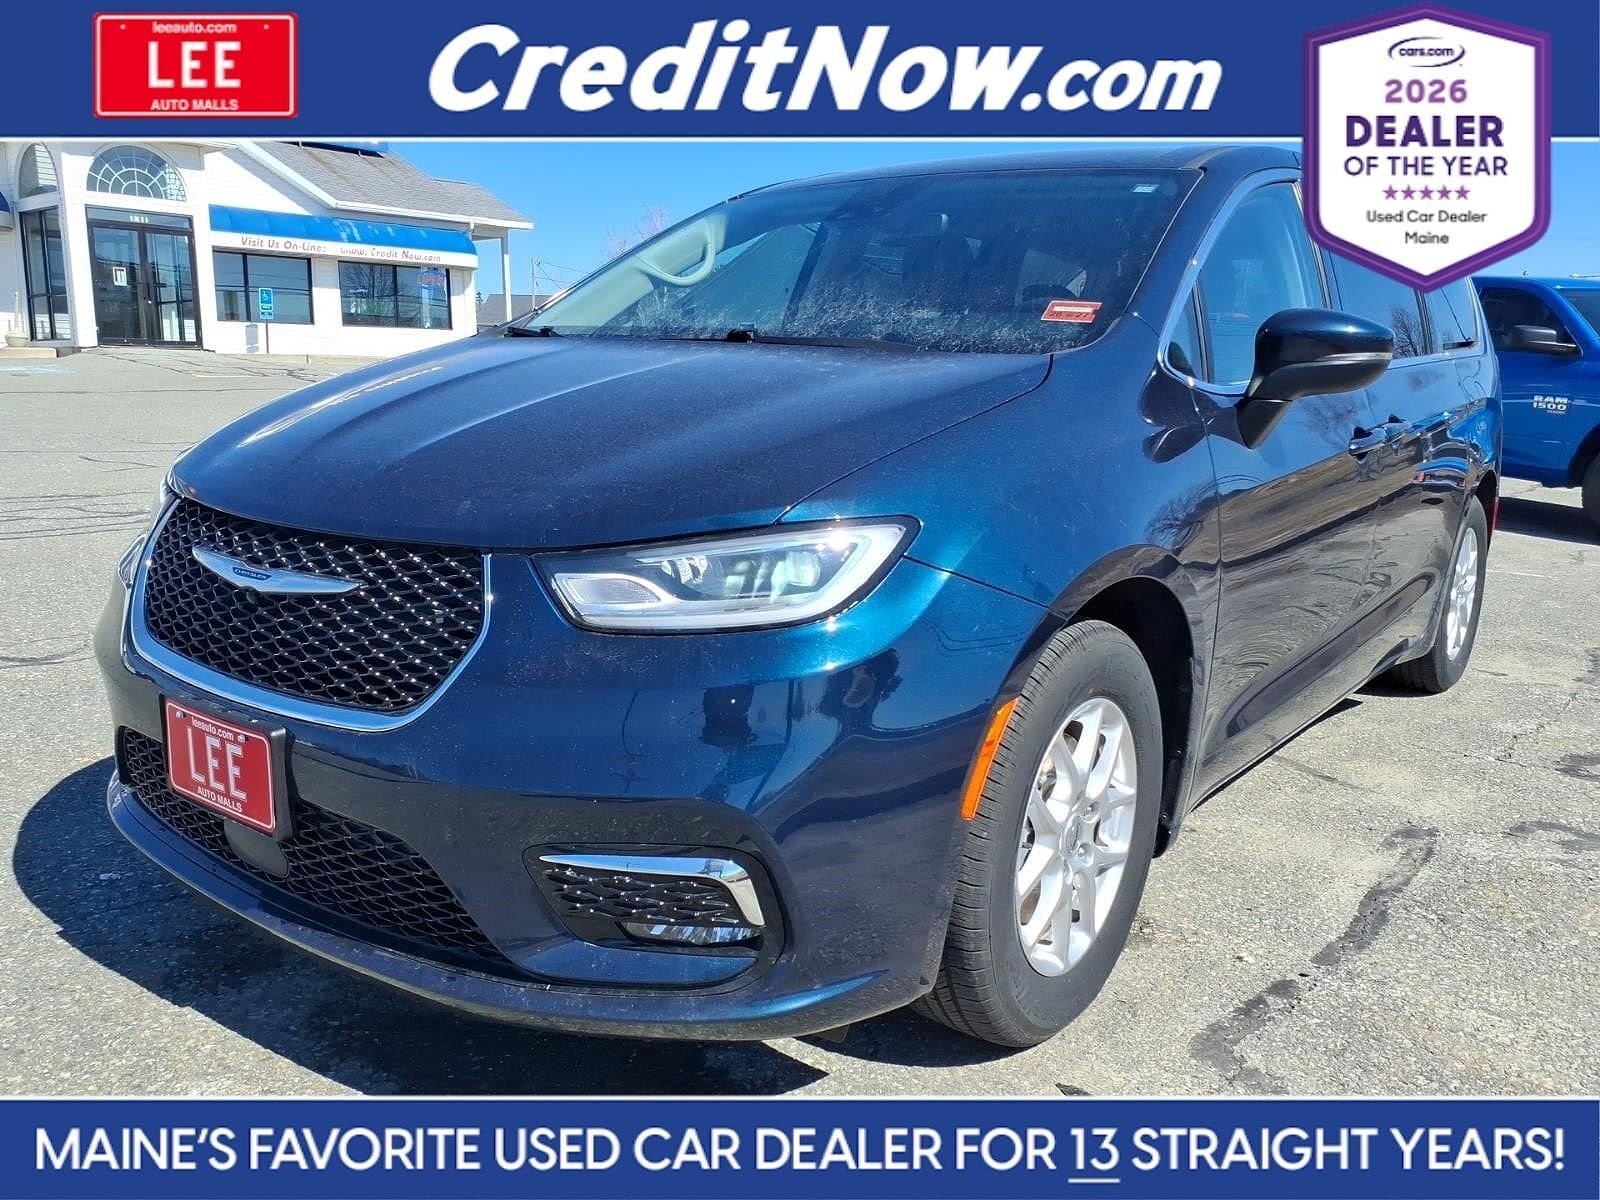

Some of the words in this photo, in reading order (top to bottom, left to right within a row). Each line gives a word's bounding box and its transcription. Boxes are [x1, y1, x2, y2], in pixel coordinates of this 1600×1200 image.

[241, 236, 264, 247] Visit
[268, 239, 280, 249] Us
[1533, 395, 1568, 403] RAM
[1533, 402, 1567, 410] 1500
[191, 716, 235, 741] leeauto.com
[187, 726, 247, 802] LEE
[197, 786, 217, 801] AUTO
[217, 794, 242, 812] MALLS
